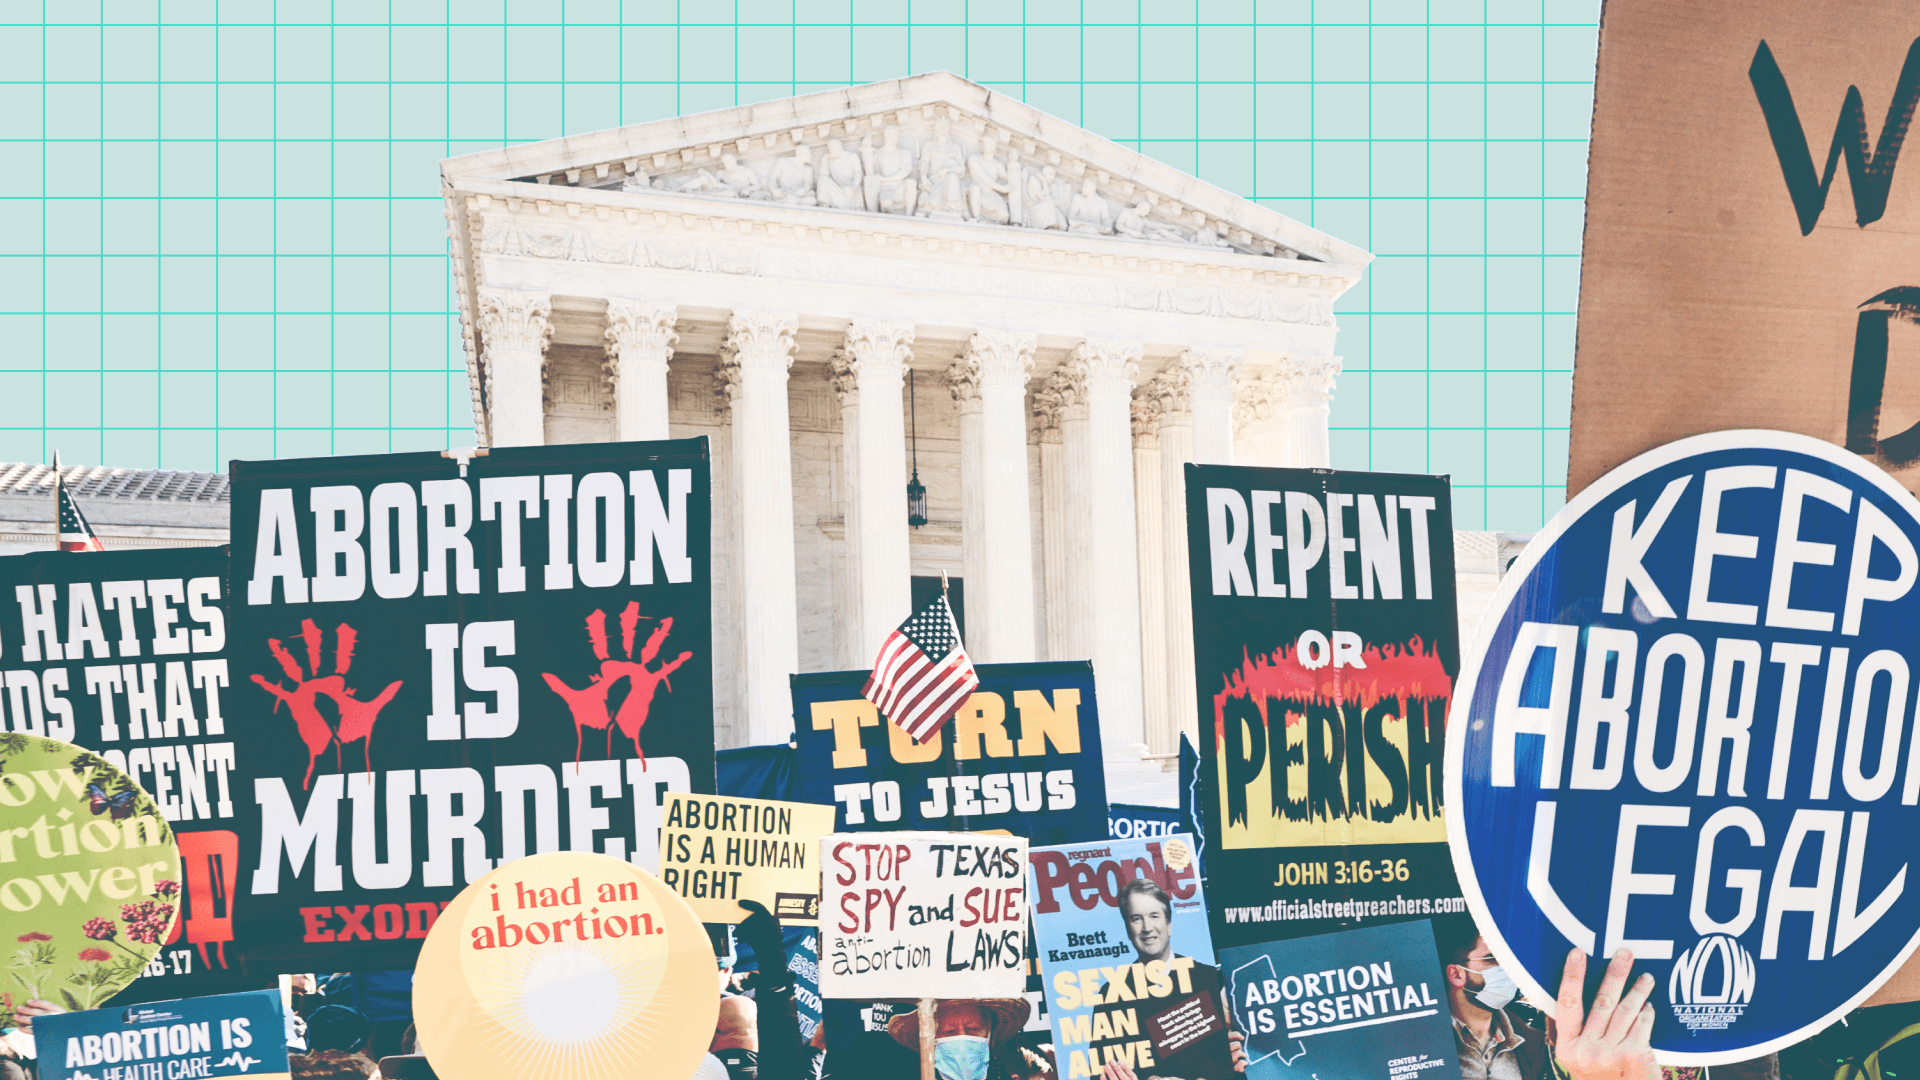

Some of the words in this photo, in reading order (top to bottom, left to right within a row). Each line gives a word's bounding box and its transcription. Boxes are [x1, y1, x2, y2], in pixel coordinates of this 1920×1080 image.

[780, 256, 862, 281] EQUAL
[870, 266, 960, 291] JUSTICE
[971, 273, 1047, 297] UNDER
[1054, 283, 1099, 300] LAW
[247, 468, 692, 606] ABORTION
[1206, 487, 1436, 600] REPENT
[1603, 465, 1919, 636] KEEP
[15, 576, 226, 662] HATES
[1297, 629, 1367, 671] OR
[84, 659, 230, 742] THAT
[425, 620, 519, 741] IS
[1220, 693, 1447, 831] PERISH
[667, 799, 791, 835] ABORTION
[833, 781, 901, 825] TO
[920, 769, 1077, 818] JESUS
[666, 834, 692, 863] IS
[700, 836, 715, 864] A
[726, 837, 806, 869] HUMAN
[832, 841, 911, 886] STOP
[929, 844, 1020, 878] TEXAS
[1067, 847, 1112, 862] regnant
[489, 883, 500, 911] i
[515, 877, 582, 909] had
[597, 881, 638, 903] an
[664, 868, 742, 899] RIGHT
[1274, 862, 1329, 887] JOHN
[1334, 859, 1410, 885] 3:16-36
[1527, 801, 1908, 961] LEGAL
[299, 900, 452, 943] EXOD
[471, 906, 664, 950] abortion.
[838, 885, 906, 934] SPY
[908, 893, 954, 926] and
[959, 886, 1023, 927] SUE
[1224, 895, 1465, 923] www.officialstreetpreachers.com
[831, 939, 931, 976] abortion
[834, 935, 874, 949] anti-
[1048, 941, 1130, 962] Kavanaugh
[1066, 930, 1107, 947] Brett
[1053, 956, 1195, 1011] SEXIST
[1245, 961, 1394, 1008] ABORTION
[1669, 936, 1756, 1004] NOW
[1058, 1008, 1140, 1046] MAN
[1247, 1007, 1277, 1035] IS
[1284, 983, 1438, 1030] ESSENTIAL
[1674, 1006, 1744, 1014] NATIONAL
[66, 1021, 211, 1068] ABORTION
[221, 1017, 252, 1050] IS
[1068, 1040, 1155, 1080] ALIVE
[1388, 1056, 1417, 1067] CENTER
[103, 1062, 162, 1080] HEALTH
[167, 1056, 213, 1079] CARE
[1389, 1058, 1445, 1074] REPRODUCTIVE
[1391, 1072, 1418, 1080] RIGHTS
